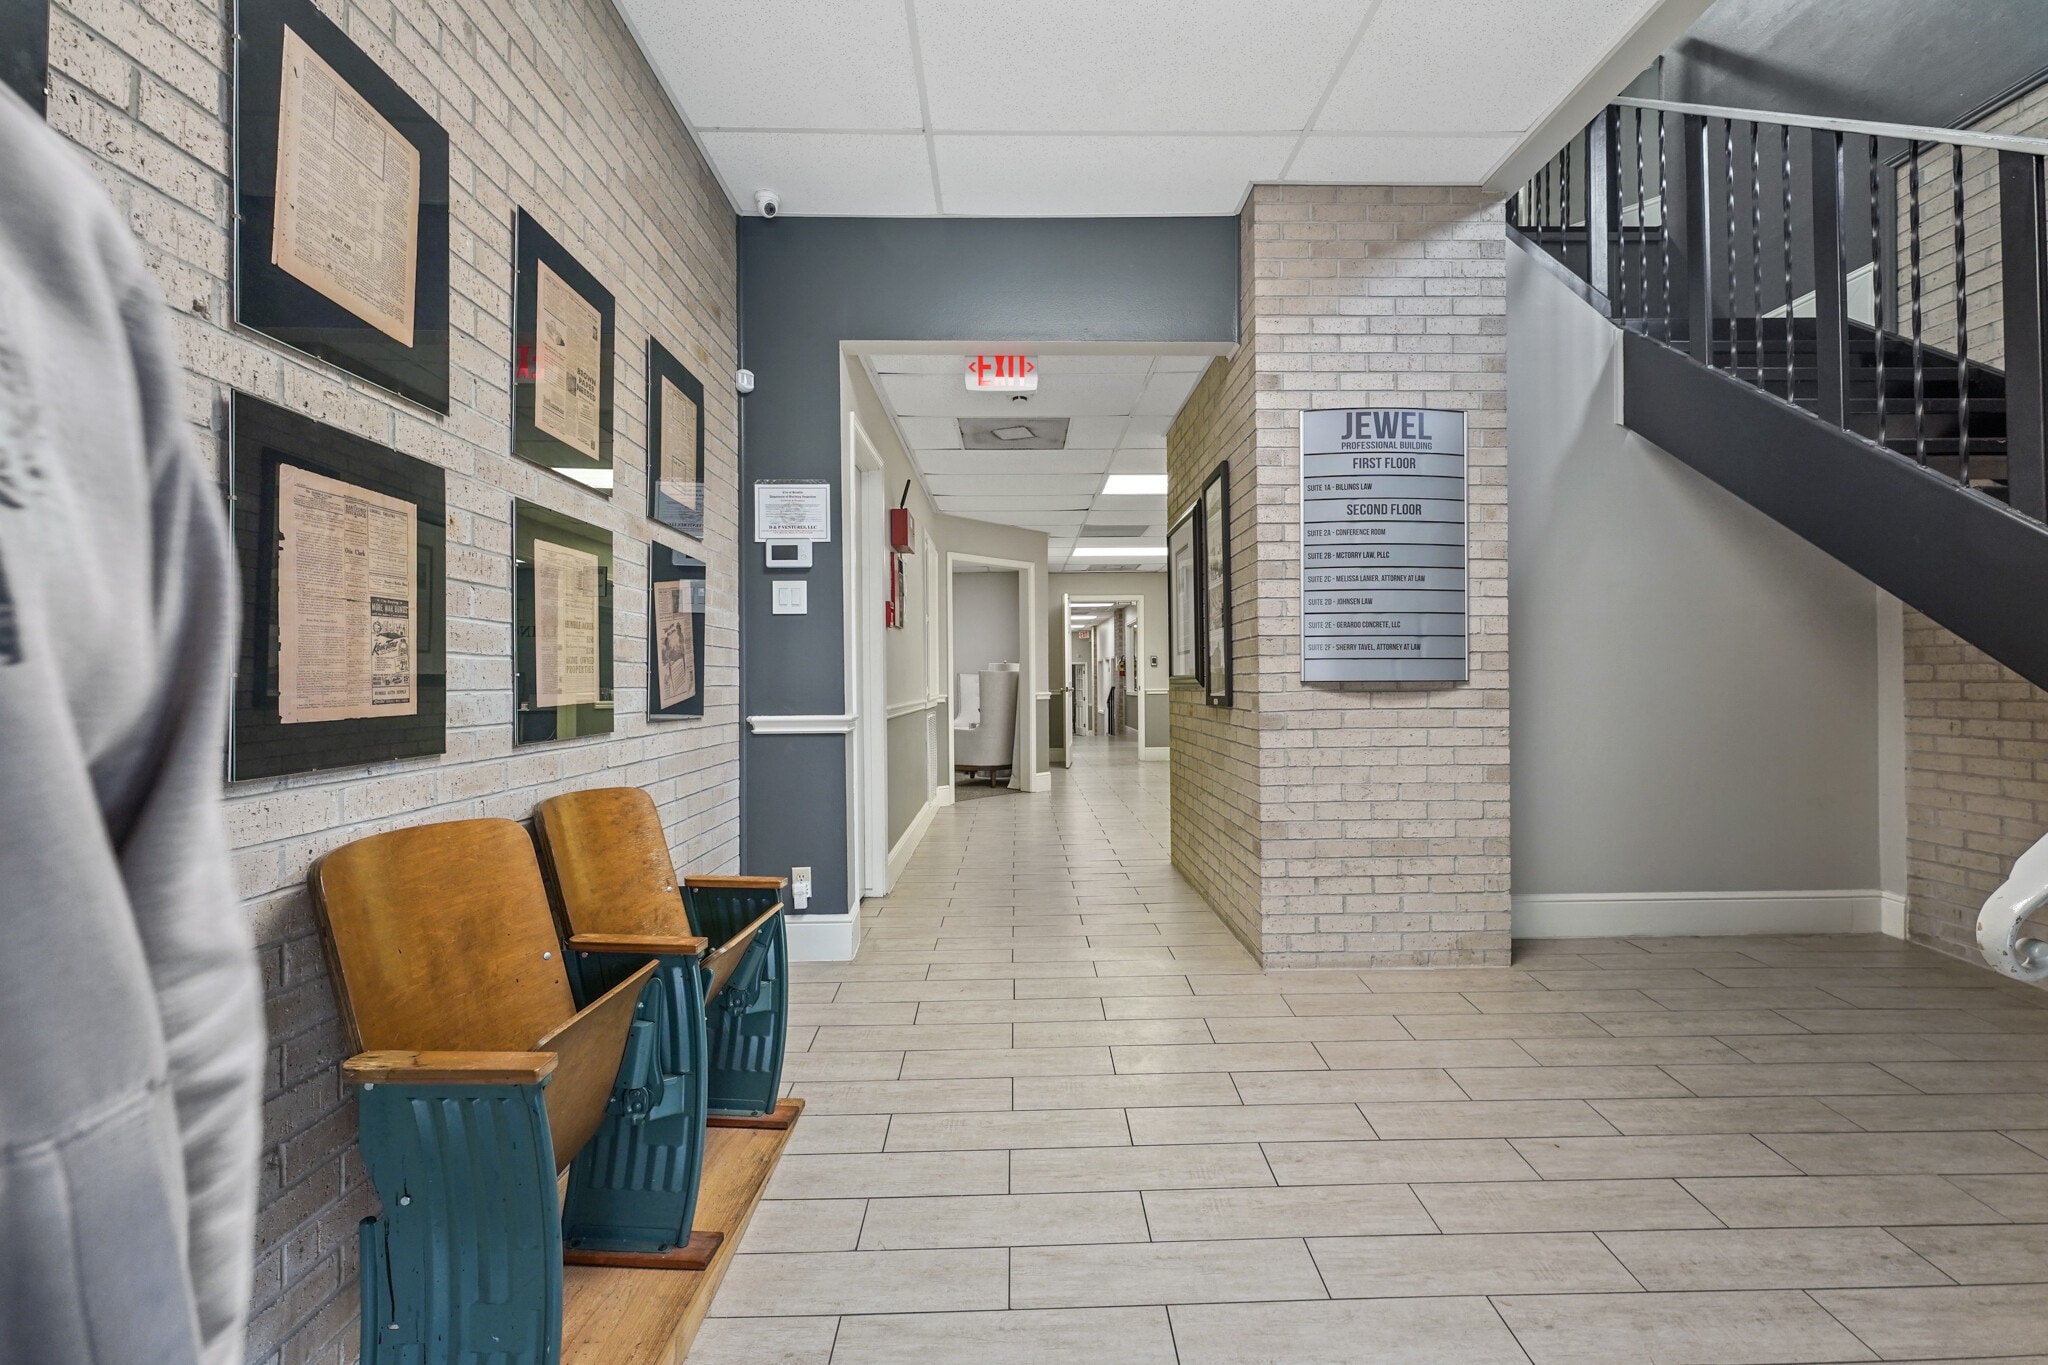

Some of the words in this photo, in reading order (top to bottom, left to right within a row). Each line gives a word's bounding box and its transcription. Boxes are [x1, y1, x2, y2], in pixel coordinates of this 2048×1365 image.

[577, 368, 596, 386] BROWN
[978, 355, 1025, 386] EXIT
[578, 376, 594, 393] PAPER
[576, 384, 596, 402] NEEDED
[1341, 412, 1432, 440] JEWEL
[1341, 441, 1397, 450] PROFESSIONAL
[1400, 442, 1432, 450] BUILDING
[1353, 458, 1382, 469] FIRST
[1385, 458, 1416, 469] FLOOR
[1347, 504, 1387, 515] SECOND
[1391, 504, 1421, 515] FLOOR
[1336, 551, 1361, 559] MCTORRY
[1358, 643, 1375, 651] TAVEL,
